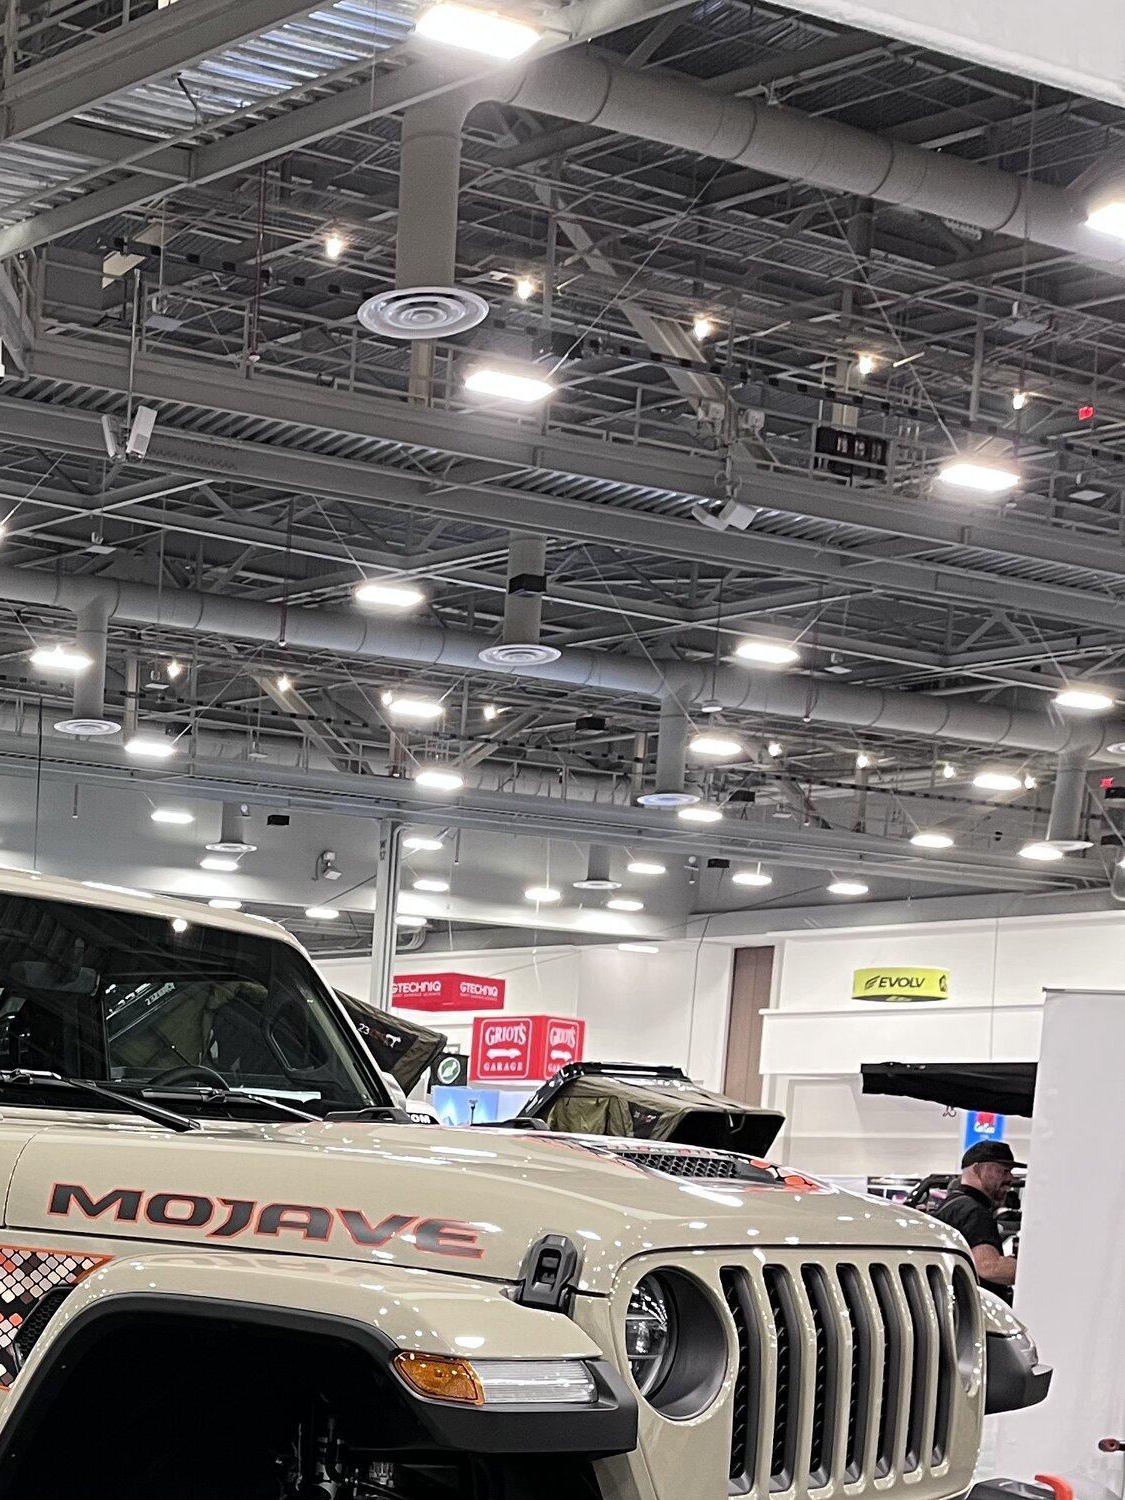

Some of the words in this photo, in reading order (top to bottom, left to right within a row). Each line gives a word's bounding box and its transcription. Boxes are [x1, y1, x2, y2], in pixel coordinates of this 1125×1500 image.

[460, 982, 498, 997] GTECHNIQ
[878, 976, 926, 988] EVOLV
[485, 1022, 527, 1046] GRIOT'S
[483, 1062, 523, 1072] GARAGE
[47, 1183, 485, 1259] MOJAVE
